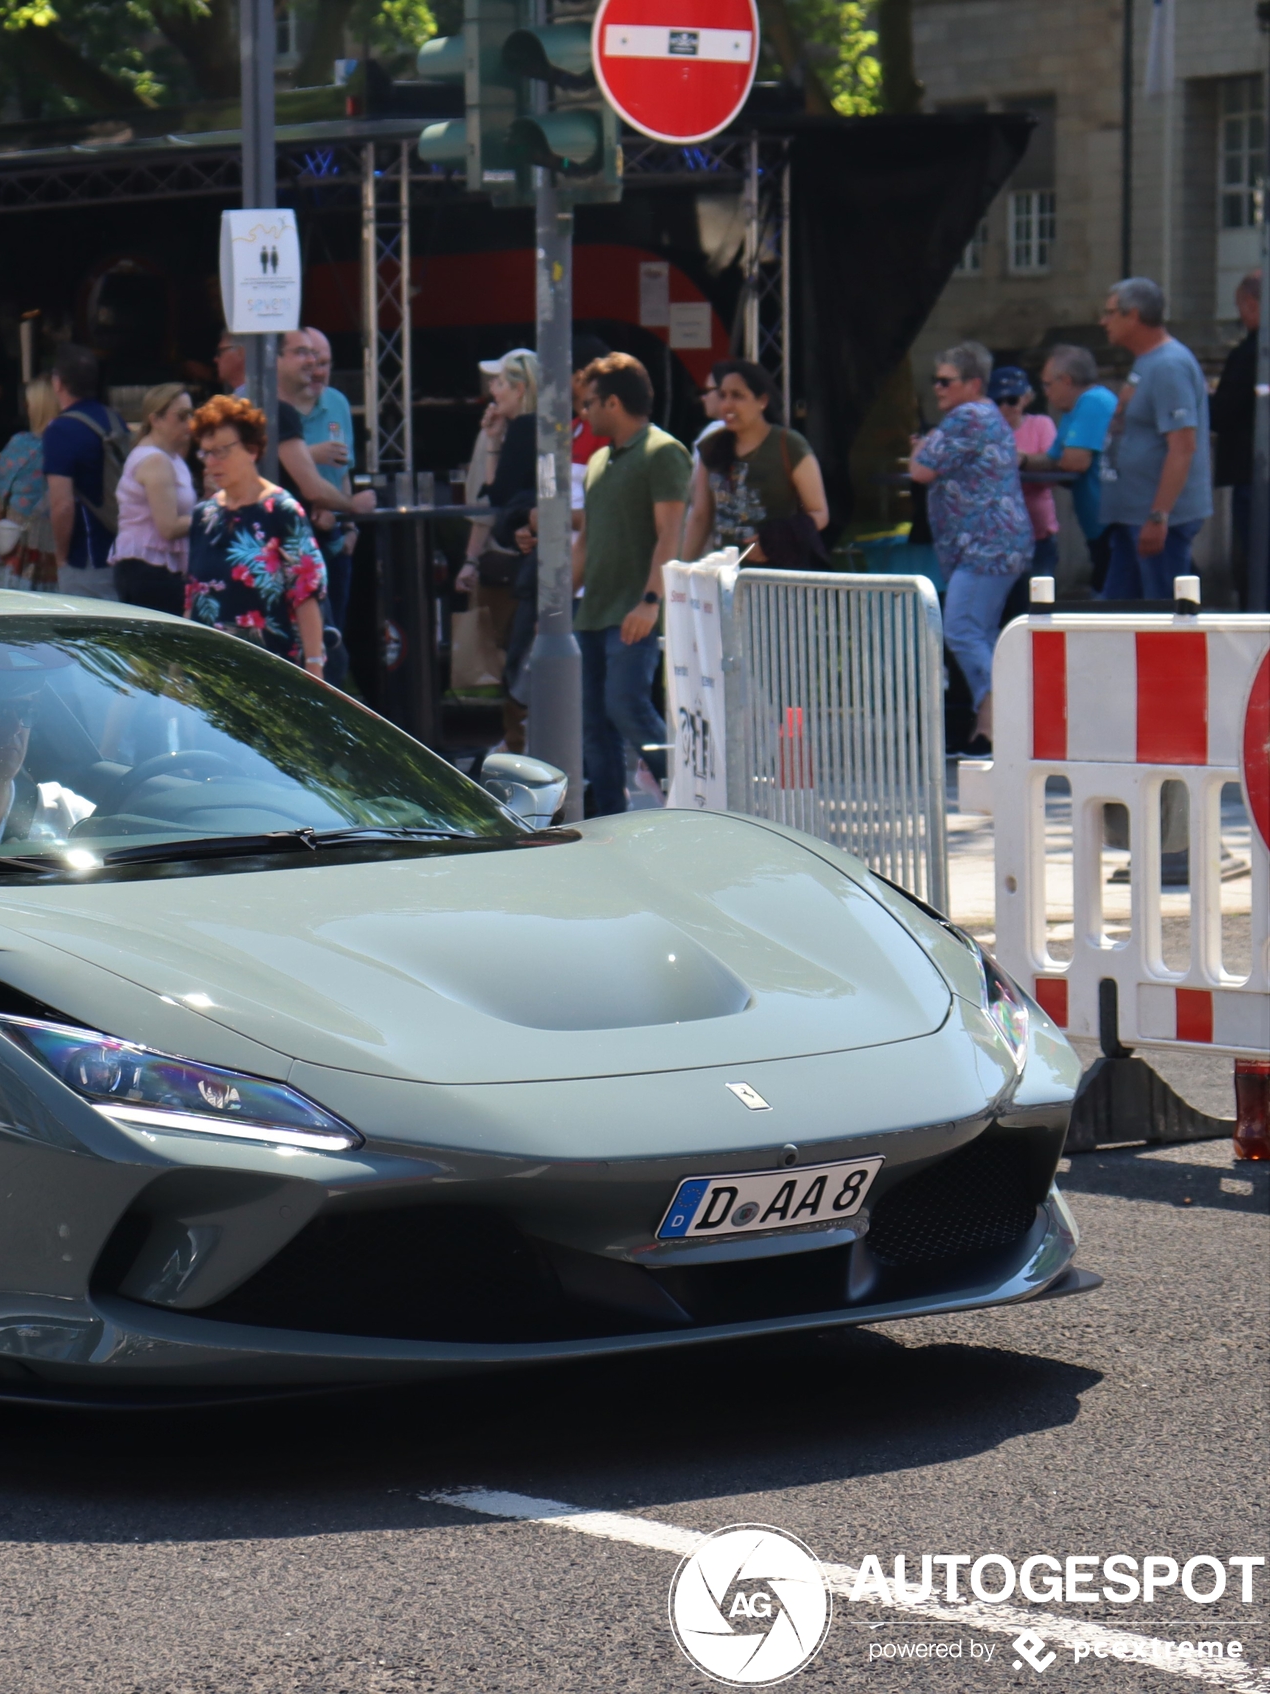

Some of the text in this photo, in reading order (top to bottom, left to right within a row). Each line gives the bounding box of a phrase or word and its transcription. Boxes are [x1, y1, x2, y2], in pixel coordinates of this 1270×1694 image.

[693, 1169, 869, 1230] D AA 8
[671, 1215, 685, 1228] D
